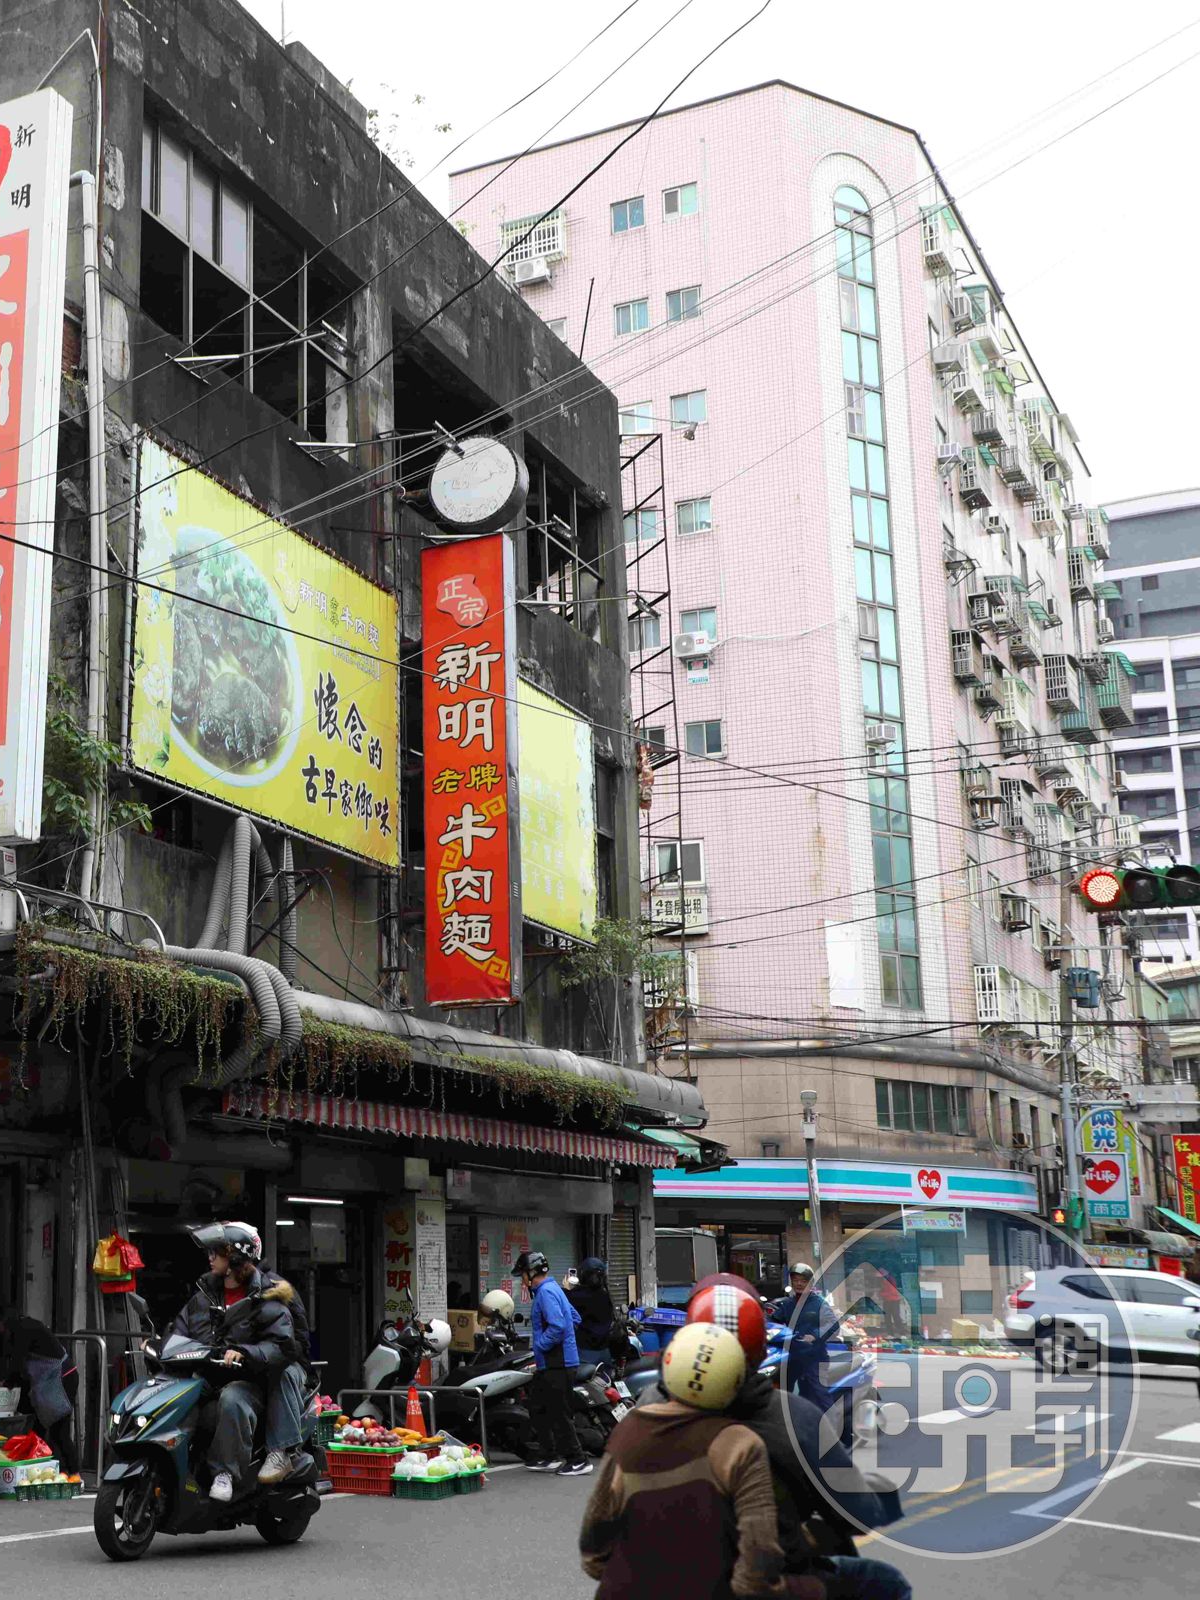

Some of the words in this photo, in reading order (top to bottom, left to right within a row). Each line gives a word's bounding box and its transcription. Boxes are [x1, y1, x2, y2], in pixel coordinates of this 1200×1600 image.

[11, 124, 37, 208] 新明
[440, 577, 486, 622] 正宗
[313, 671, 383, 771] 懷念的
[432, 641, 502, 752] 新明
[301, 754, 392, 837] 古早家鄉味
[432, 763, 502, 794] 老牌
[438, 802, 498, 962] 牛肉麵
